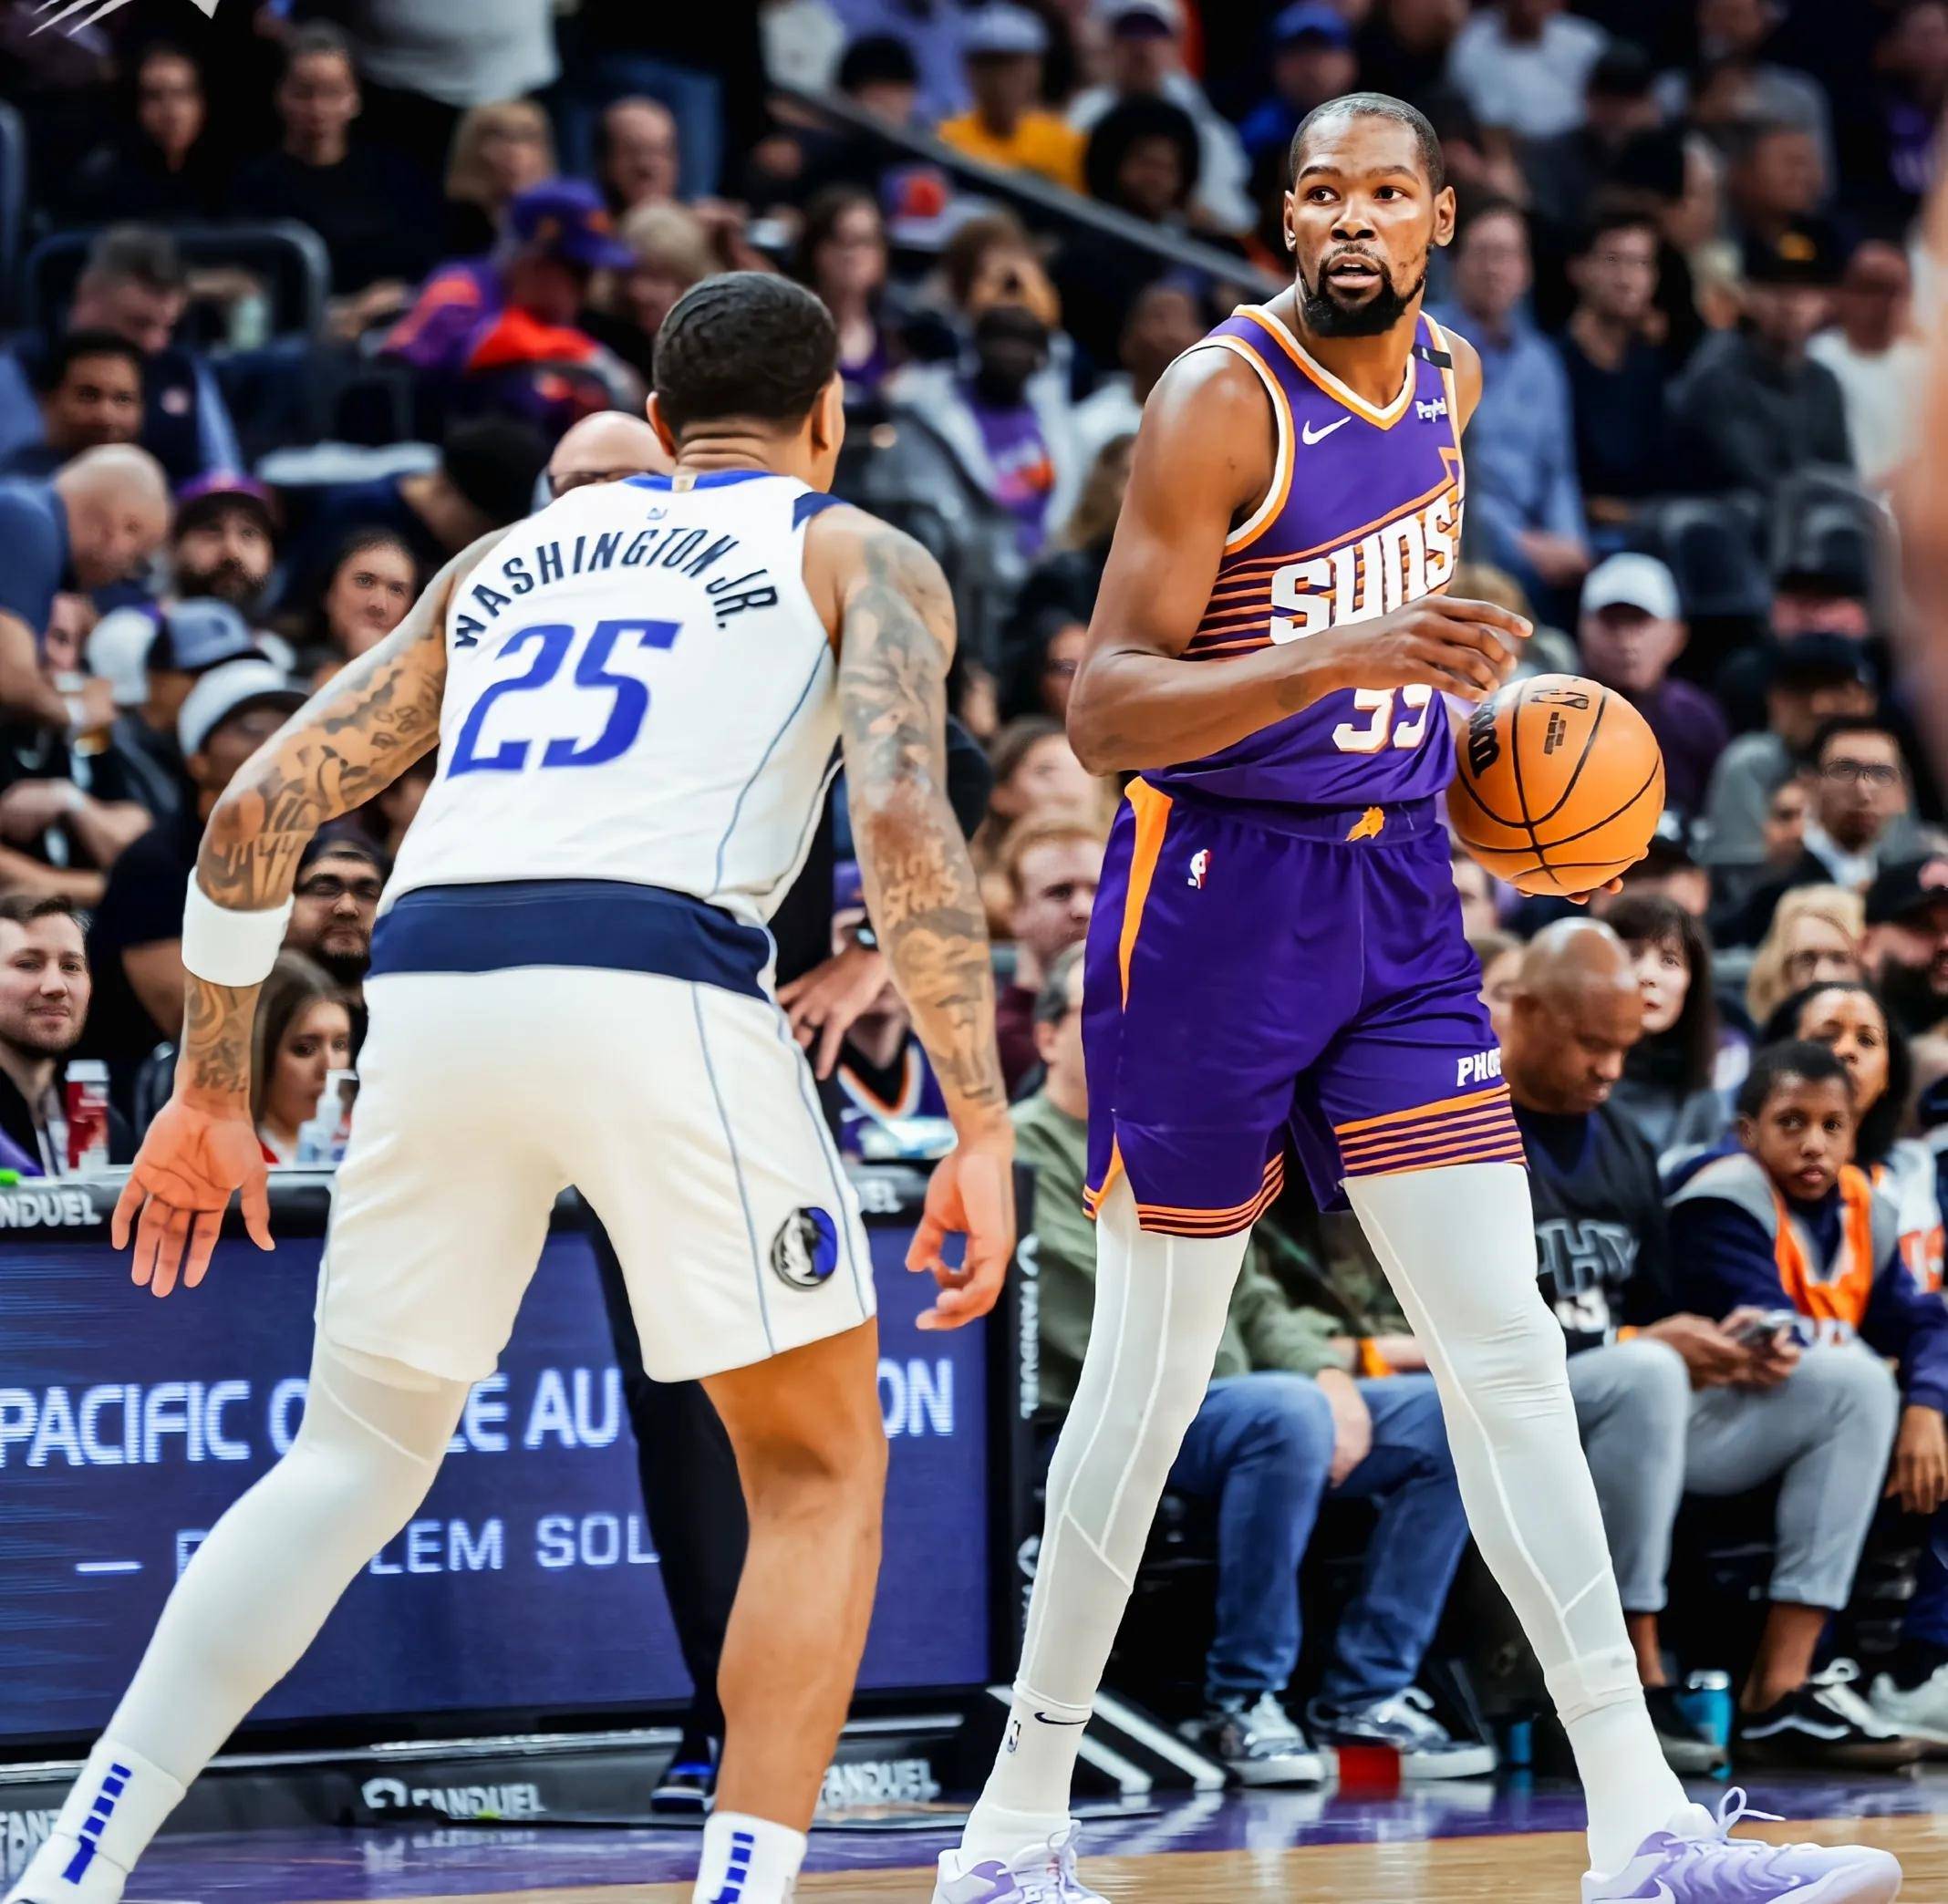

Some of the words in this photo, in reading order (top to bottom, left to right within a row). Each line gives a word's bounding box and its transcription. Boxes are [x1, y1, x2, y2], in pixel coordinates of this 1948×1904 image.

[454, 527, 740, 648] WASHINGTON
[705, 568, 778, 628] JR.
[1269, 495, 1455, 645] SUNS
[444, 618, 684, 781] 25
[0, 1380, 252, 1467] PACIFIC
